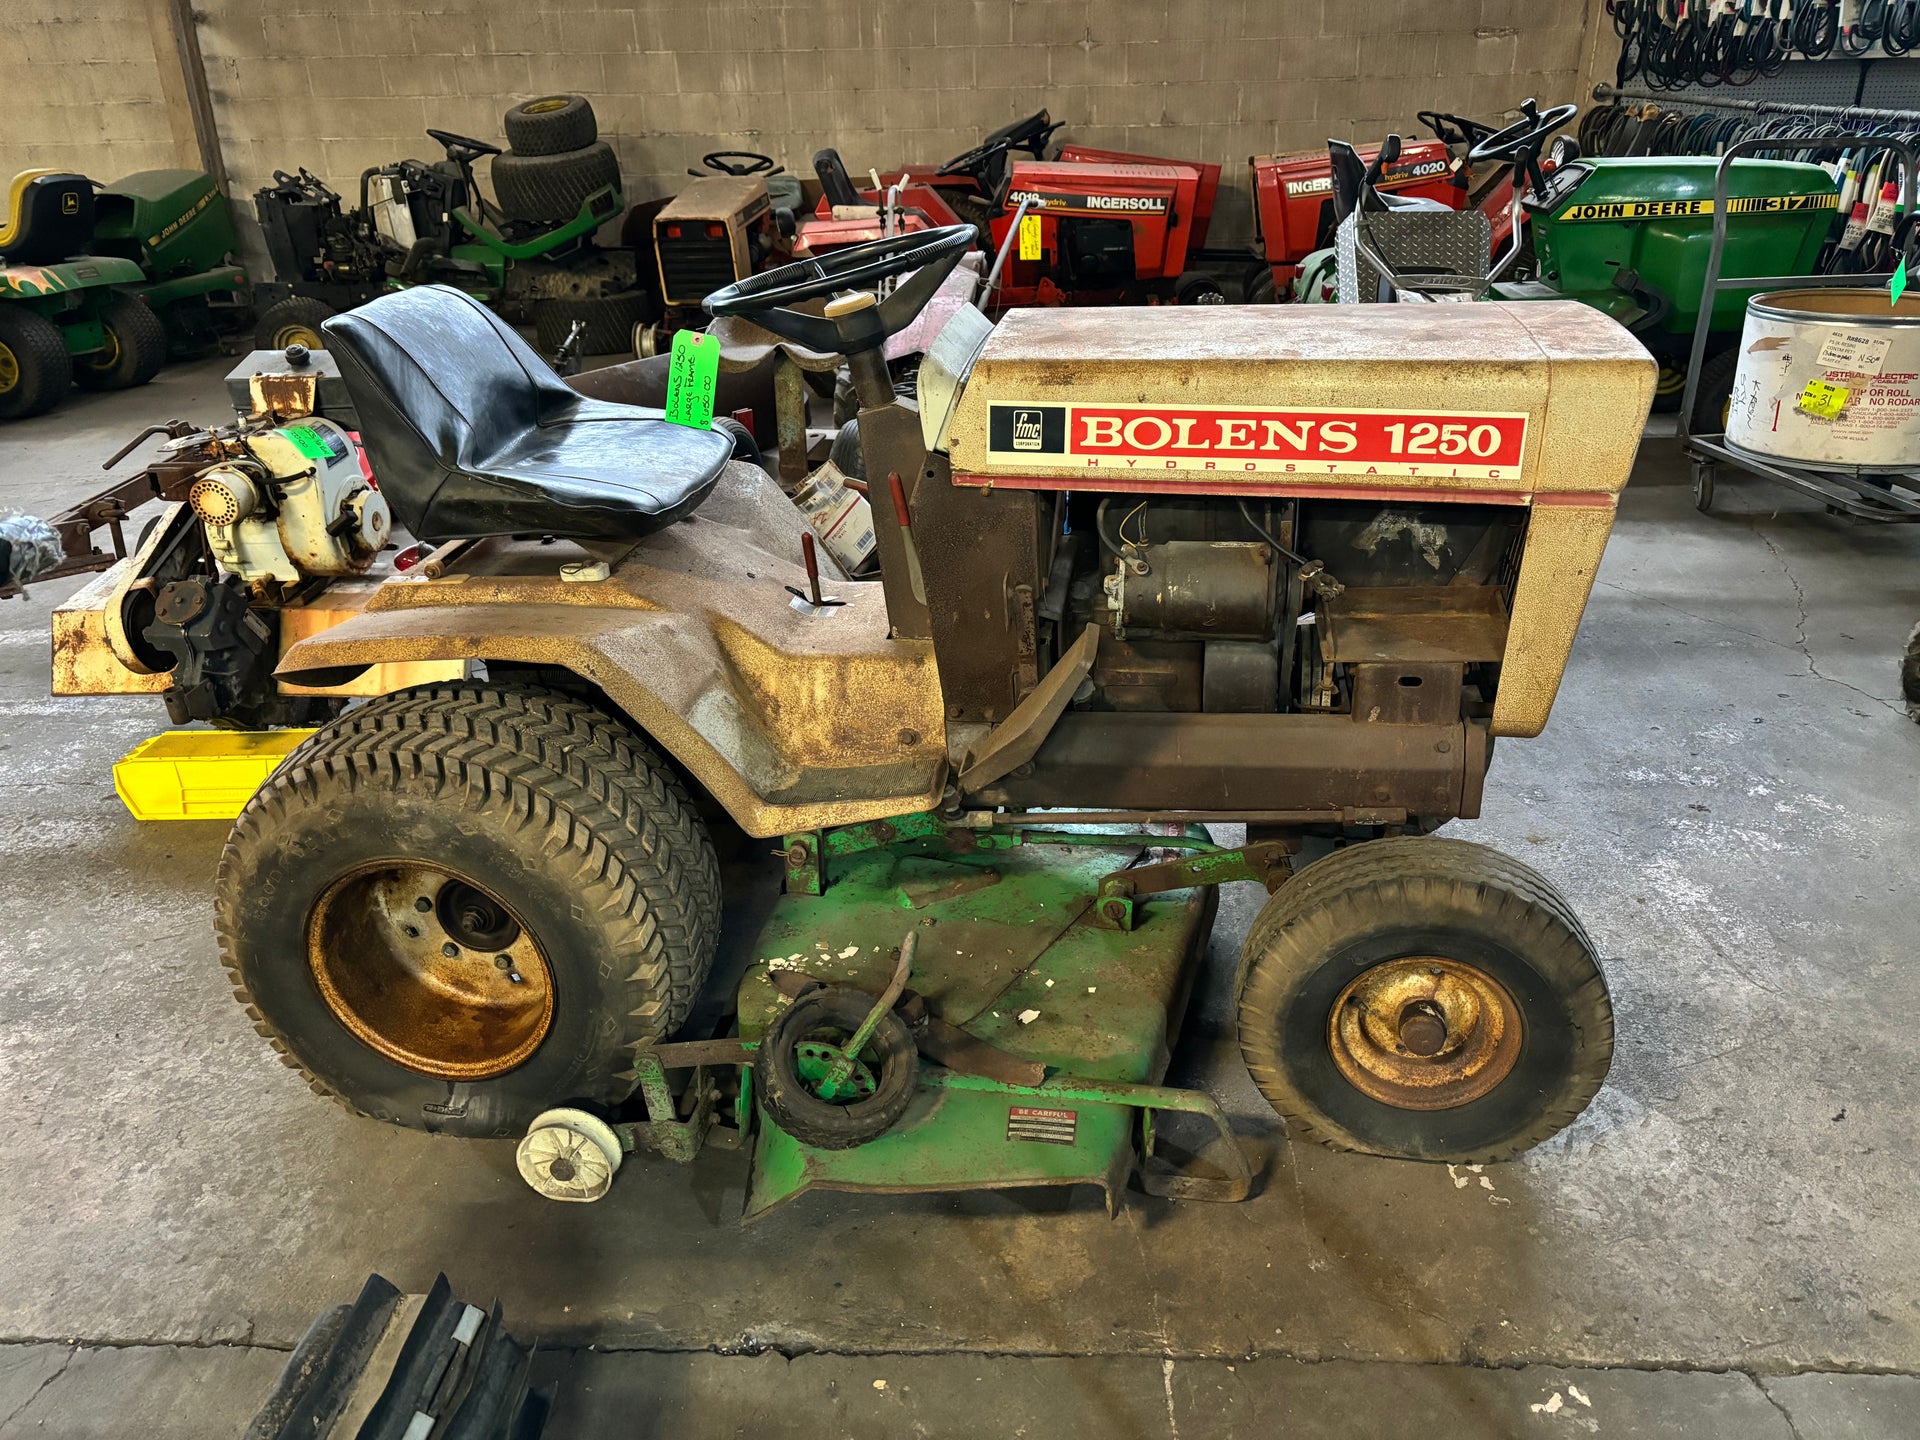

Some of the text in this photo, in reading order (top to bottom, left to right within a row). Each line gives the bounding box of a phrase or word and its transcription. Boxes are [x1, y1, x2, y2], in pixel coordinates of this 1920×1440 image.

[1384, 161, 1446, 182] hydriv 4020
[1288, 178, 1333, 194] INGER
[1086, 195, 1166, 211] INGERSOLL
[1571, 200, 1701, 219] JOHN DEERE
[1766, 195, 1808, 212] 317
[161, 206, 198, 239] JOHN DEERE
[668, 344, 686, 420] BOLENS 1250
[683, 354, 700, 422] LARGE FRAME
[1817, 393, 1833, 407] 31
[1851, 387, 1912, 397] TIP OR ROLL
[1869, 398, 1885, 406] NO
[1887, 398, 1920, 406] RODAR
[1015, 412, 1041, 438] fmc
[1079, 415, 1502, 457] BOLENS 1250
[1087, 458, 1501, 479] HYDROSTATIC
[1031, 1110, 1068, 1119] CAREFUL
